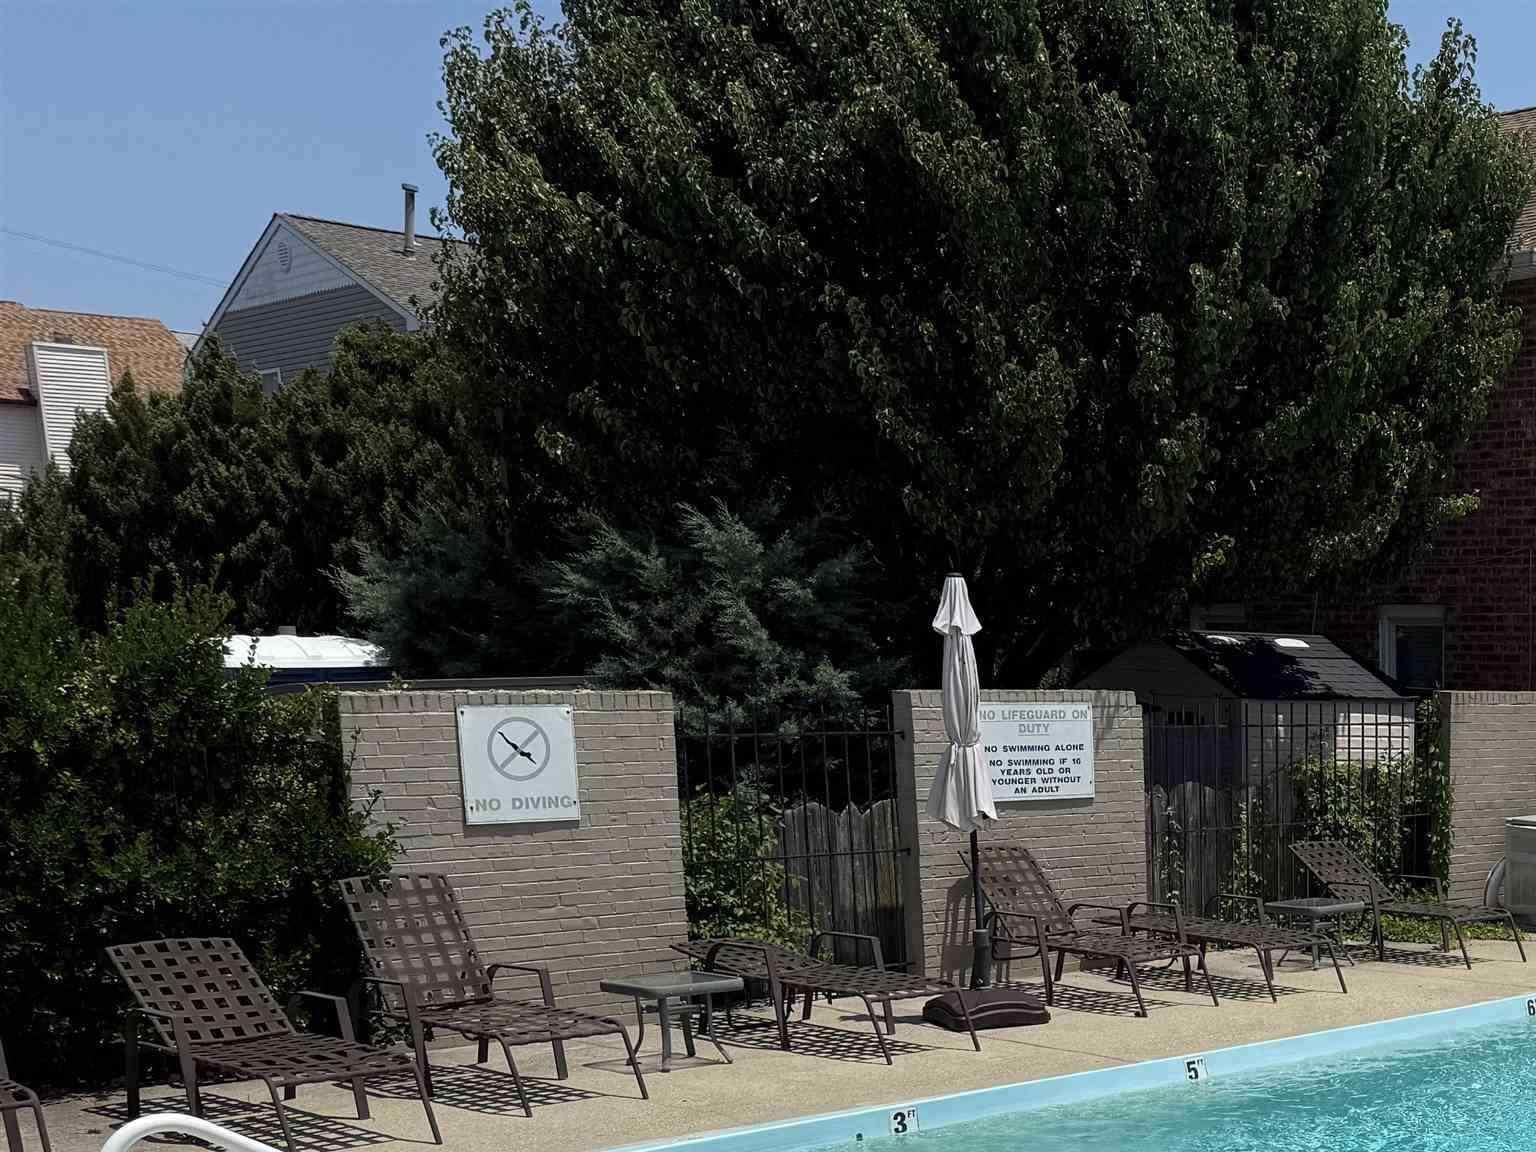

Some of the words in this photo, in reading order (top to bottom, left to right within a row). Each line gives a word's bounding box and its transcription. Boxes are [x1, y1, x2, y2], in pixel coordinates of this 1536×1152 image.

[980, 710, 995, 720] NO
[1002, 710, 1066, 720] LIFEGUARD
[1072, 710, 1087, 720] ON
[1019, 723, 1049, 733] DUTY
[984, 745, 998, 753] NO
[989, 759, 1003, 767] NO
[1007, 758, 1055, 766] SWIMMING
[1000, 768, 1032, 776] YEARS
[1036, 767, 1054, 775] OLD
[991, 777, 1036, 785] YOUNGER
[1041, 776, 1081, 784] WITHOUT
[1014, 786, 1027, 794] AN
[475, 799, 501, 811] NO
[512, 796, 572, 810] DIVING
[1527, 999, 1536, 1016] 6
[1186, 1060, 1199, 1080] 5
[893, 1112, 907, 1134] 3
